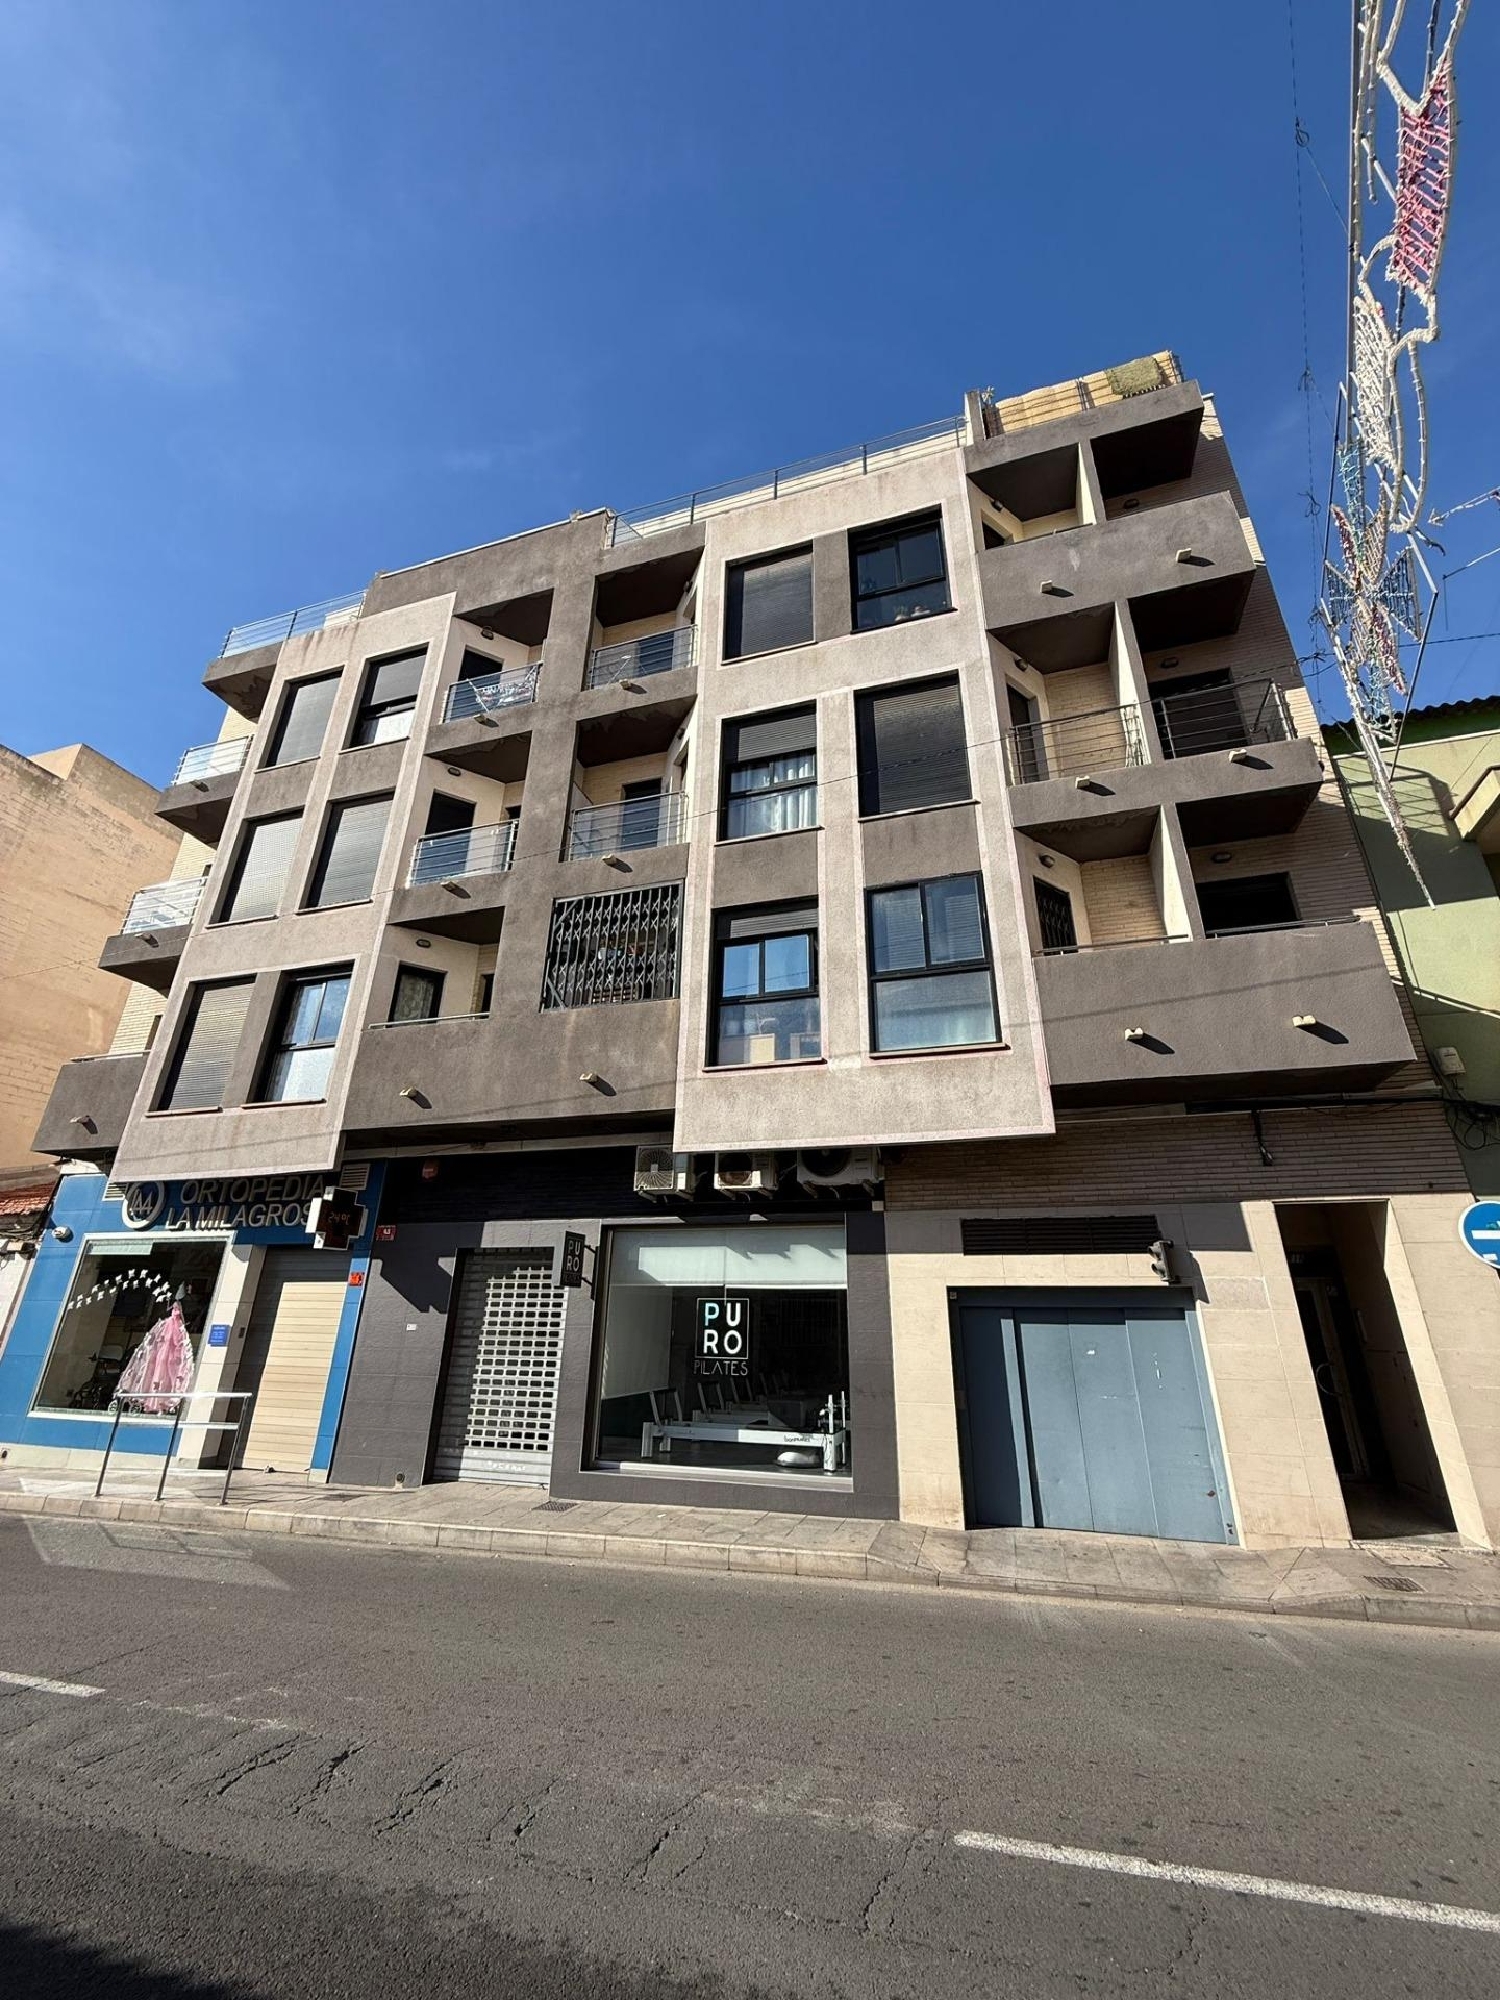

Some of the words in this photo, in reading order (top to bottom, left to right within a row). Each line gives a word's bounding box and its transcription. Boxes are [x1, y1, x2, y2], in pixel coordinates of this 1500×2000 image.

[180, 1175, 325, 1204] ORTOPEDIA
[165, 1207, 191, 1229] LA
[693, 1359, 749, 1376] PILATES
